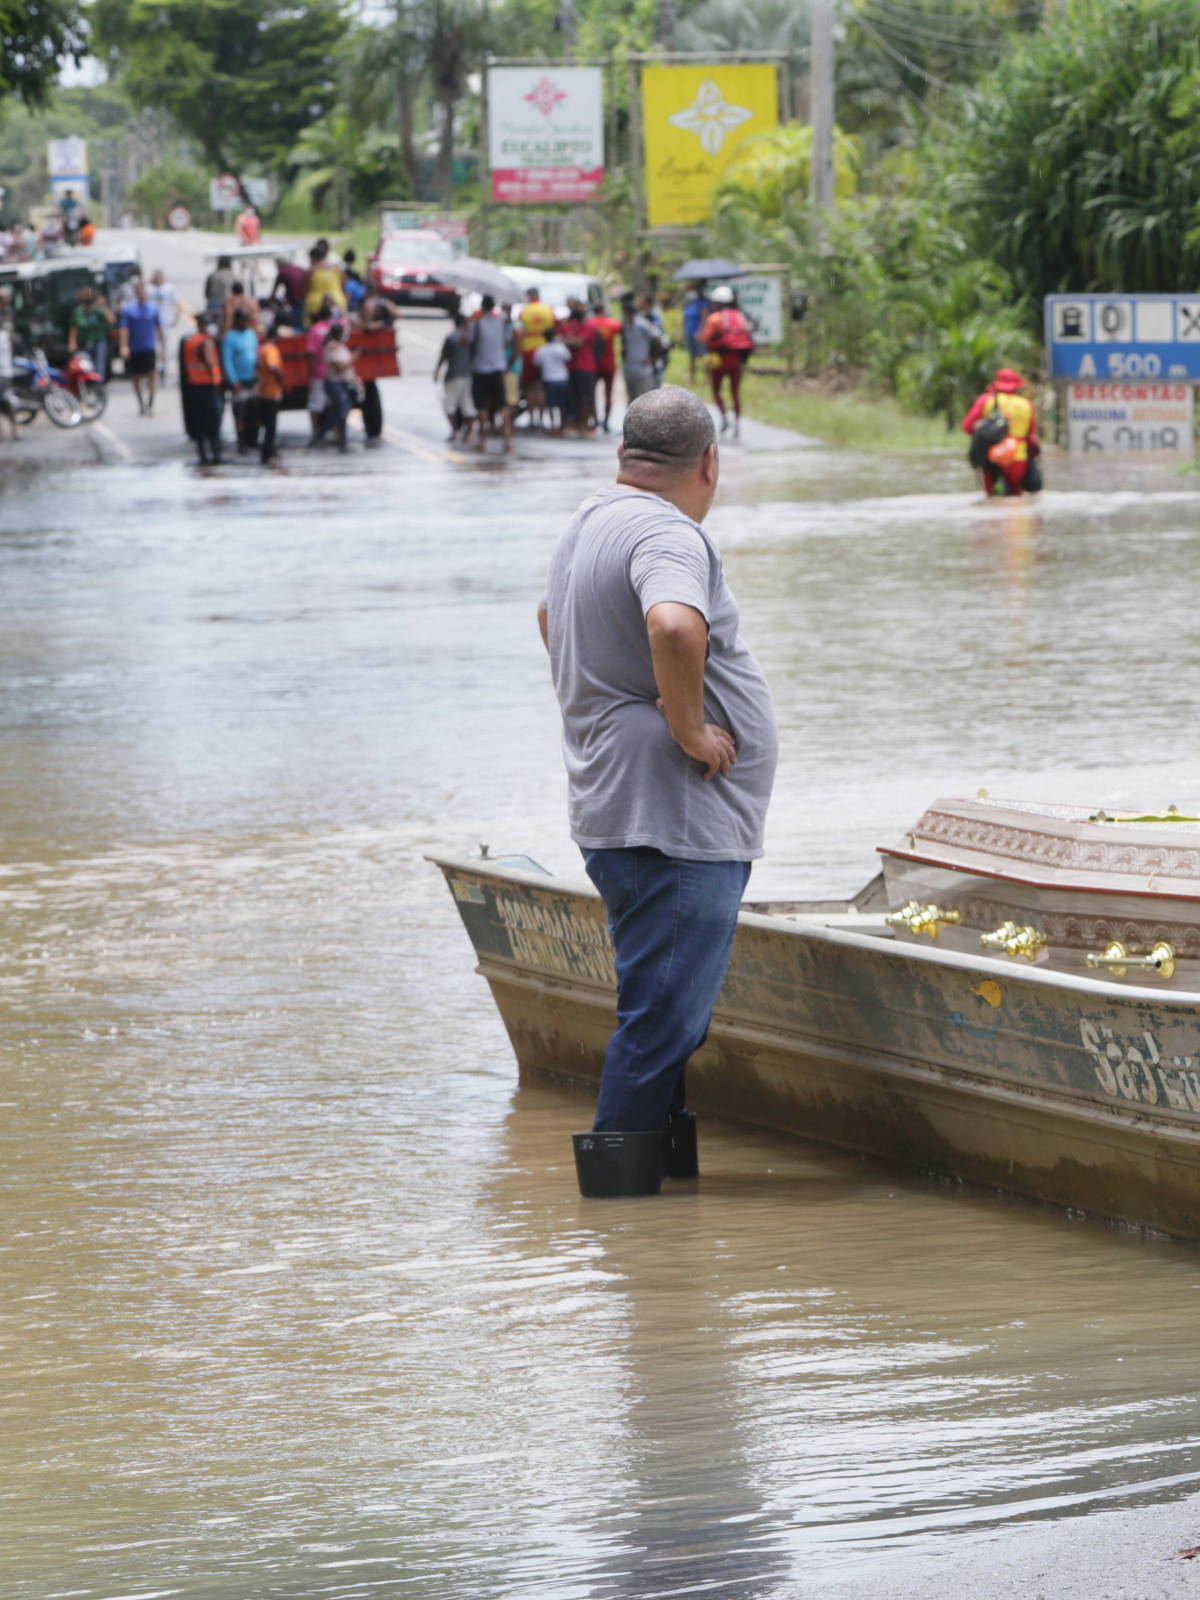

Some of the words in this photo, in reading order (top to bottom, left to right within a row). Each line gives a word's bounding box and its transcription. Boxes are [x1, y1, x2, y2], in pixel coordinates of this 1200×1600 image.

[1078, 353, 1098, 378] A
[1108, 352, 1161, 377] 500
[1168, 364, 1188, 378] m
